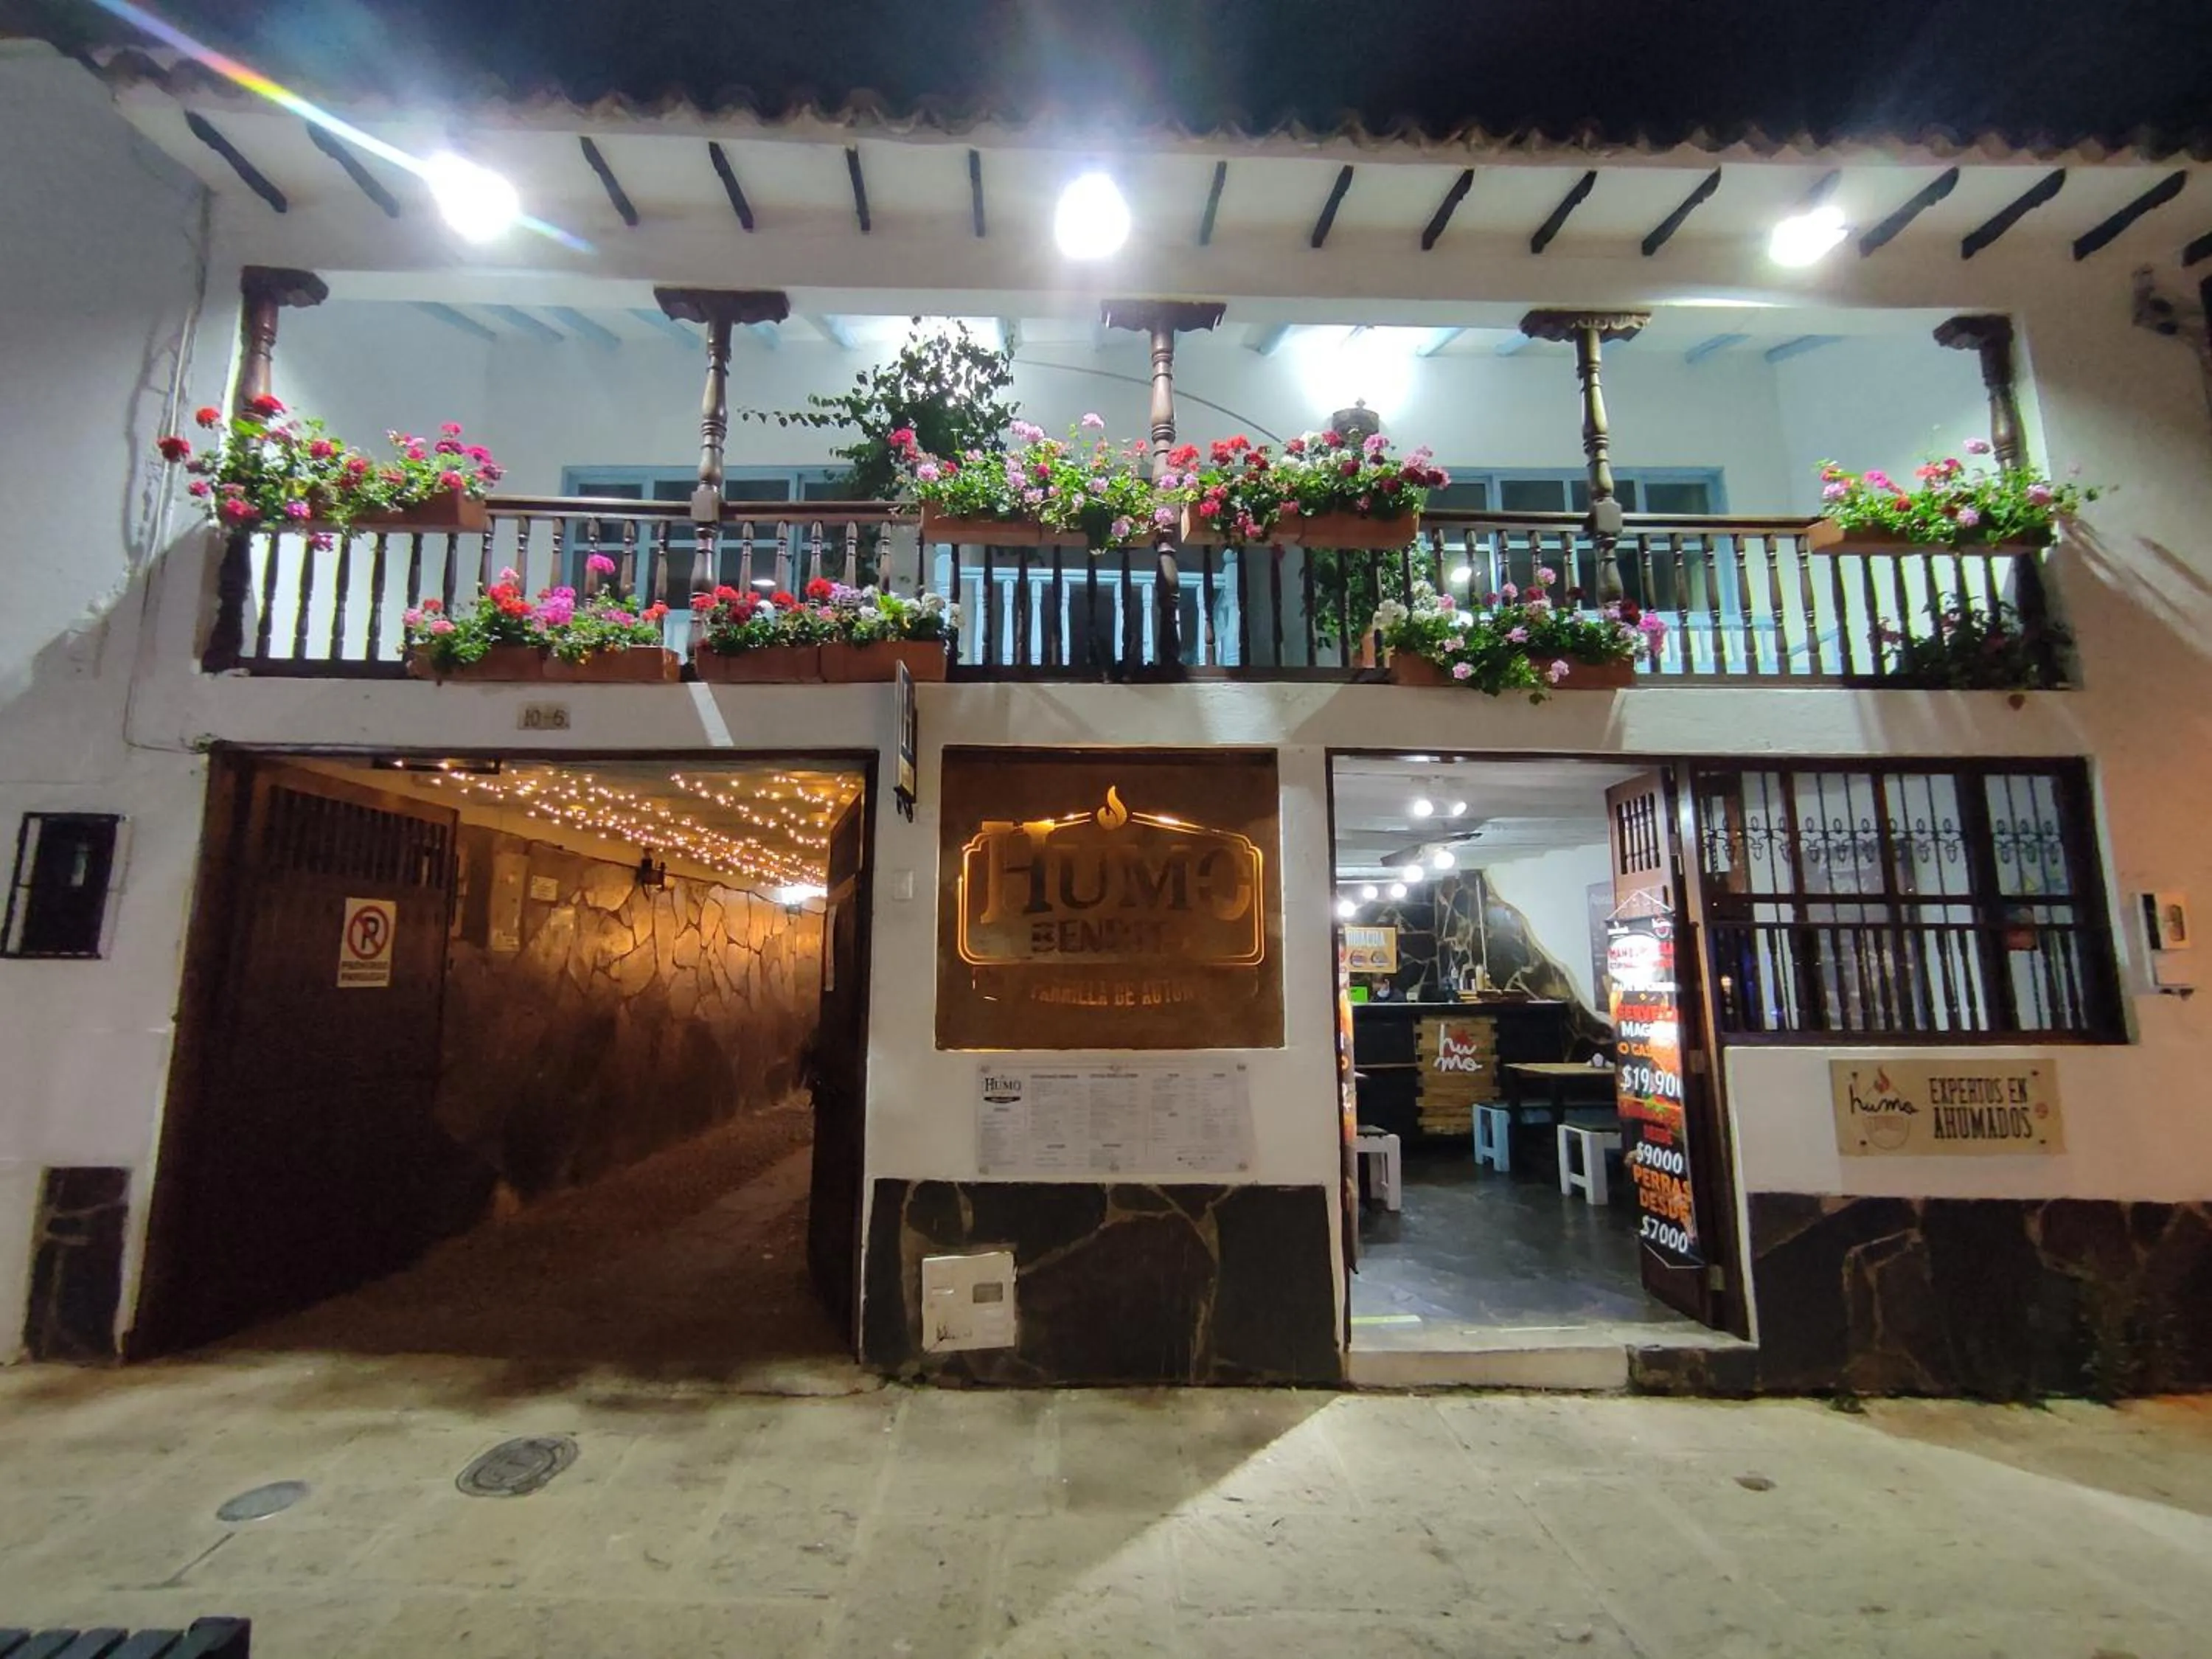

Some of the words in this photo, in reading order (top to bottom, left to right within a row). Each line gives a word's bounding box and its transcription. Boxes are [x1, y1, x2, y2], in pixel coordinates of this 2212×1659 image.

[980, 821, 1253, 922] HUMO
[984, 1077, 1022, 1092] HUMO
[1928, 1077, 2005, 1105] EXPERTOS
[2007, 1077, 2028, 1104] EN
[1933, 1107, 2033, 1139] AHUMADOS
[1636, 1141, 1683, 1175] $9000
[1632, 1164, 1691, 1199] PERRAS
[1640, 1215, 1688, 1253] $7000
